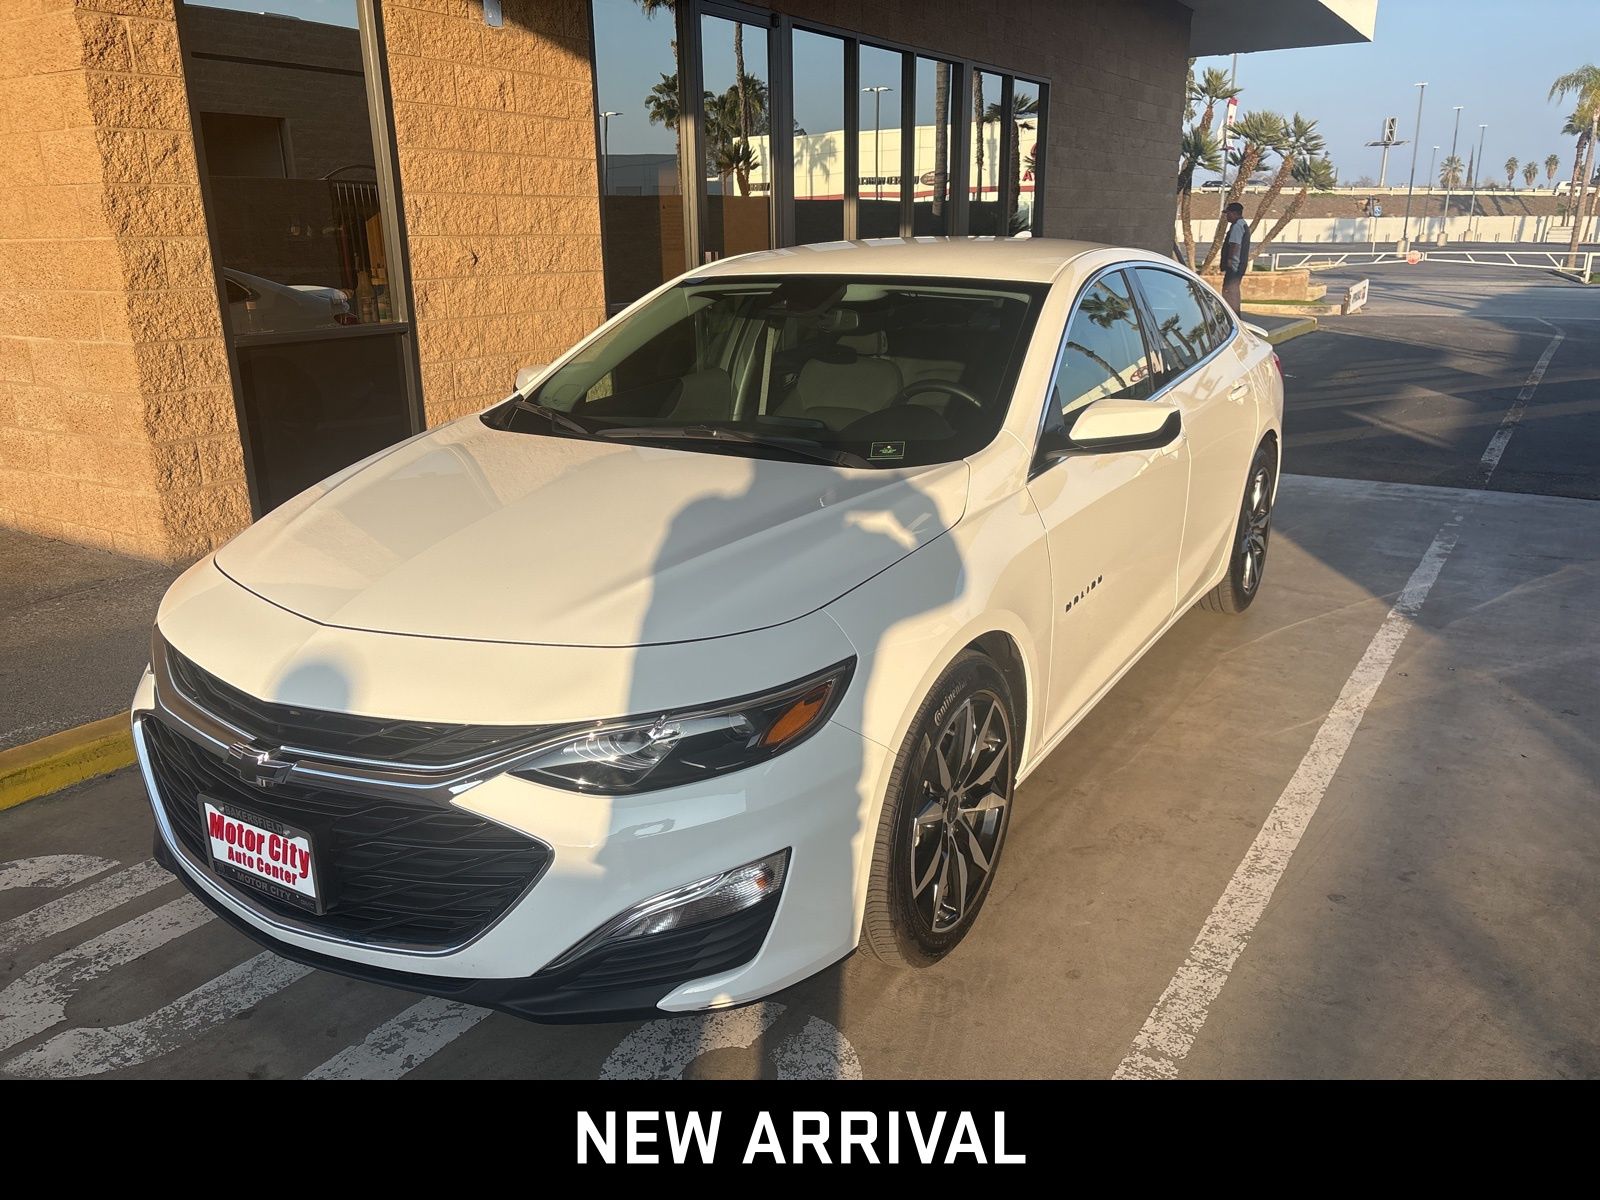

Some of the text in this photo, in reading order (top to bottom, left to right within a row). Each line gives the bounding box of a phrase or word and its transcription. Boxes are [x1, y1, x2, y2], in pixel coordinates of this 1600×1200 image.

[224, 805, 285, 832] BAKERSFIELD
[208, 811, 310, 879] Motor City
[228, 846, 298, 885] Auto Center
[236, 872, 291, 901] MOTOR CITY
